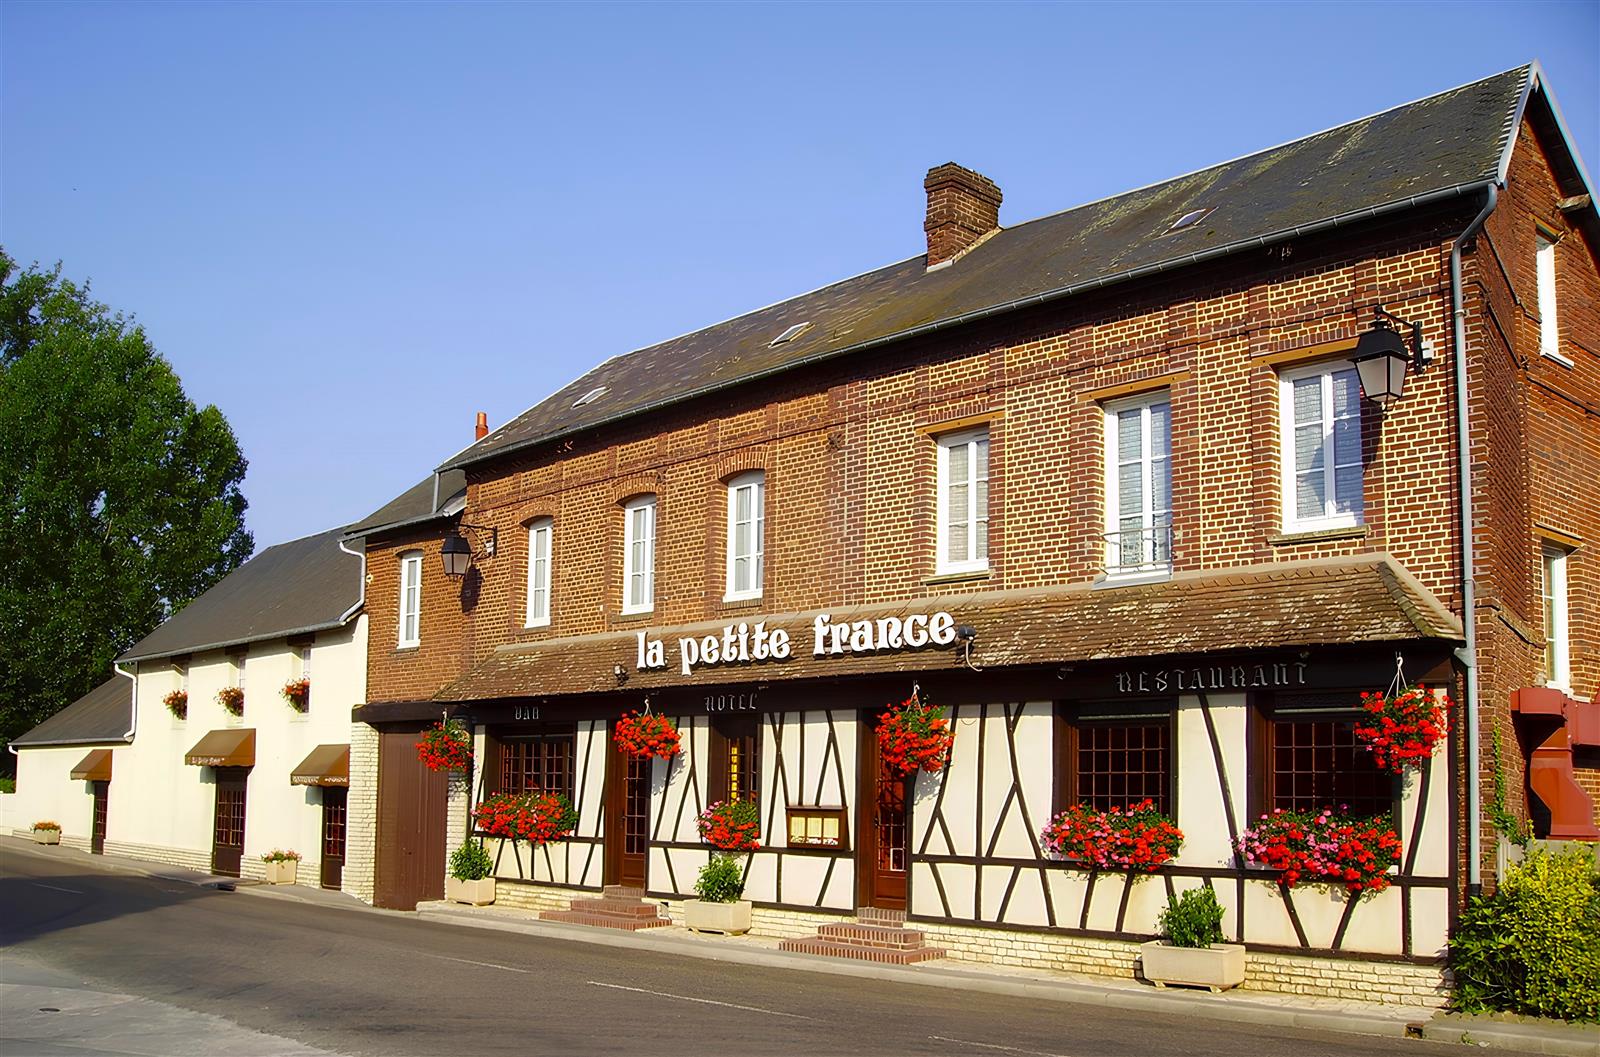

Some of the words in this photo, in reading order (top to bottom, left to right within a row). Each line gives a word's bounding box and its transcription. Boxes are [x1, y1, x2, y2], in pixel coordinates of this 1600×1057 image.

[636, 630, 666, 669] la
[679, 621, 791, 676] petite
[812, 611, 957, 656] france
[1115, 661, 1307, 693] RESTAURANT
[703, 692, 758, 712] HOTEL
